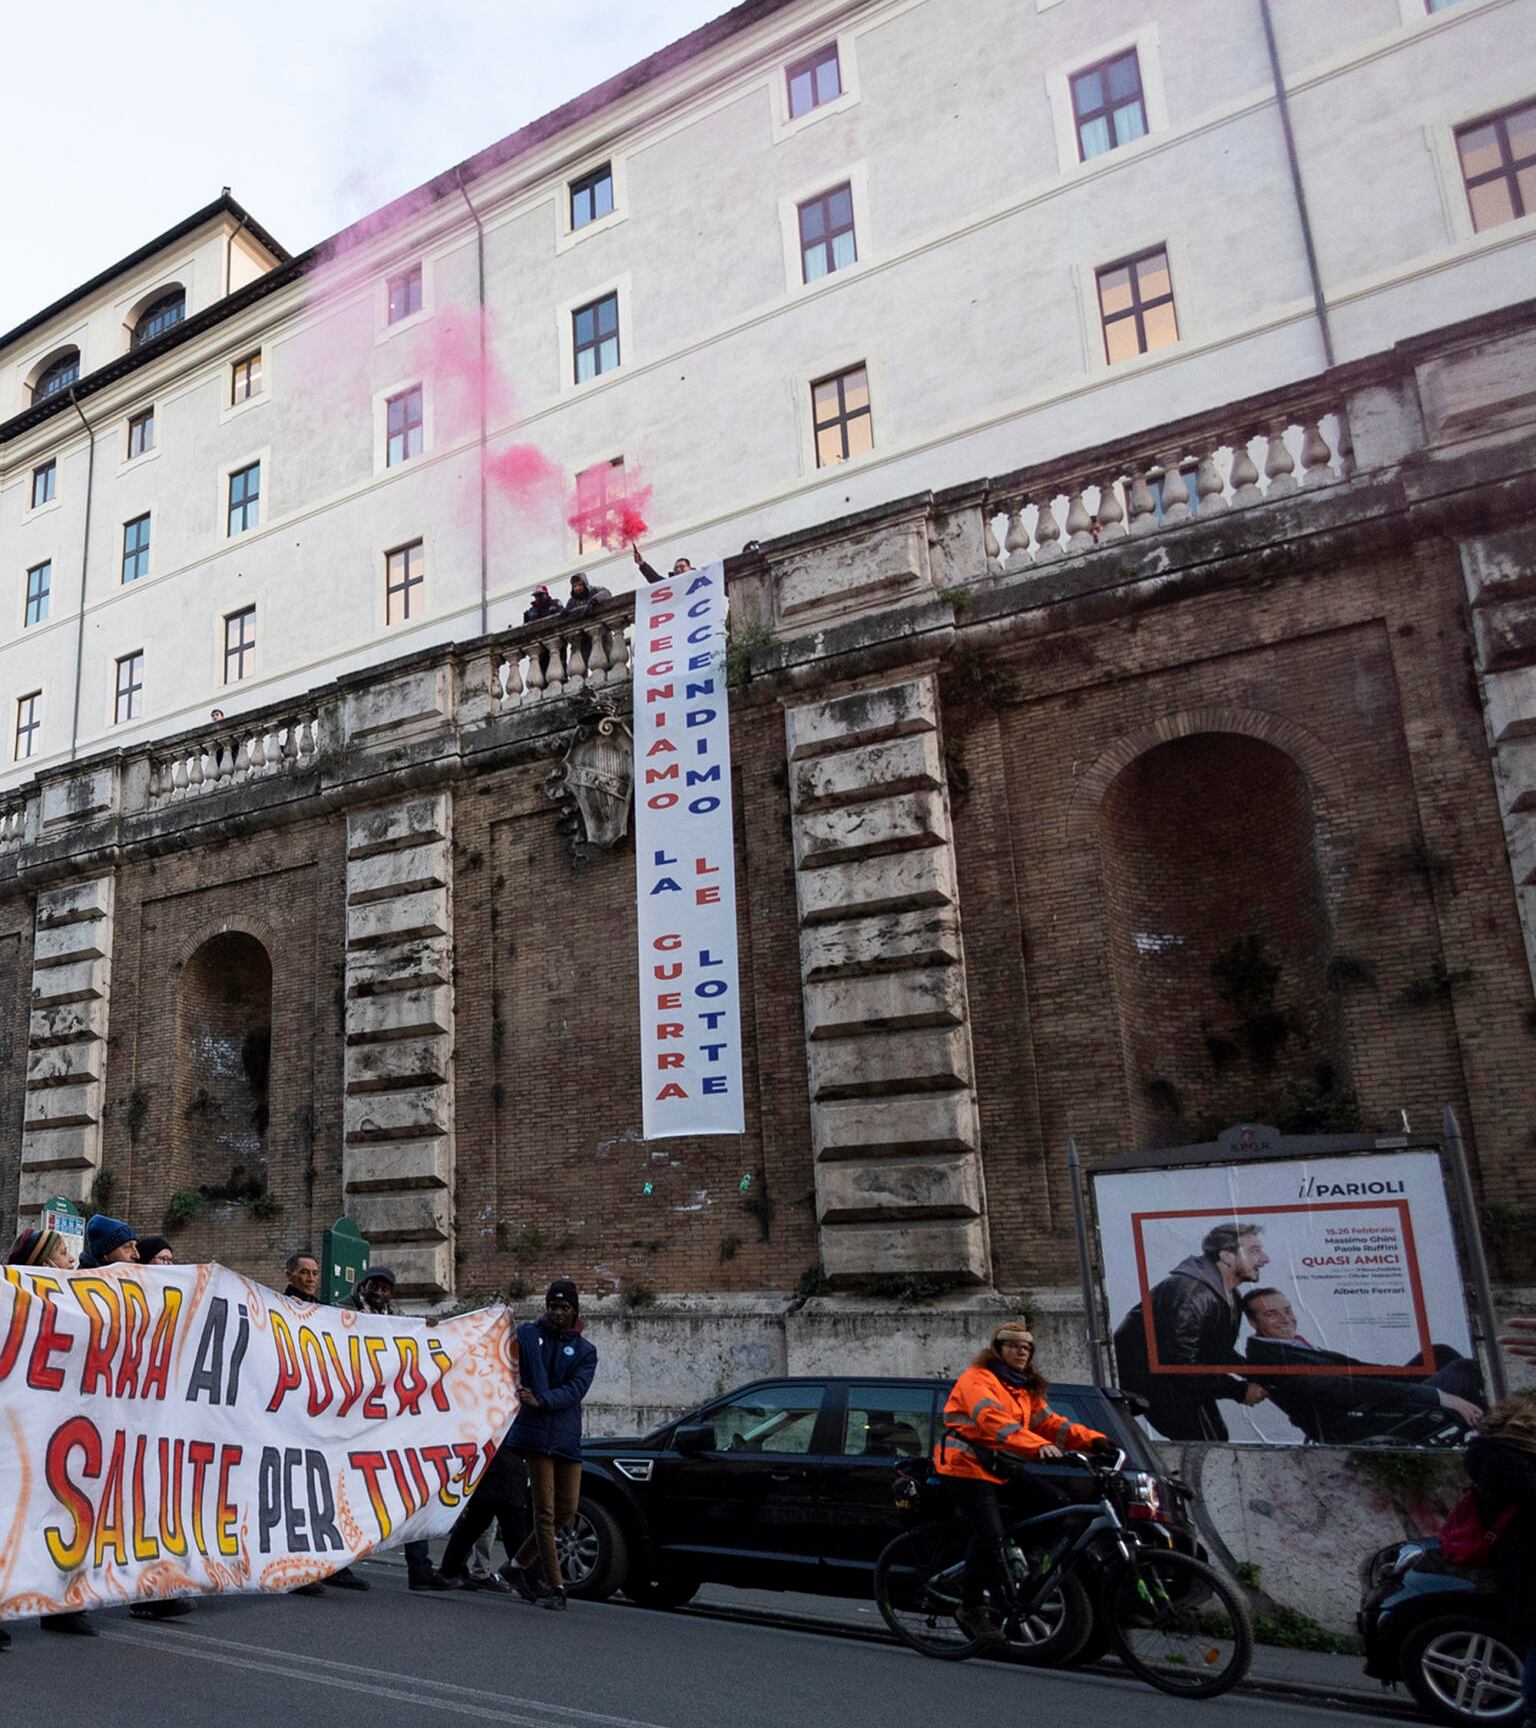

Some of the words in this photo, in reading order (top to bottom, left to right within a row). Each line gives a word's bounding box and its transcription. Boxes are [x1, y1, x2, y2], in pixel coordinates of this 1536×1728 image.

[645, 585, 680, 810] SPEGNIAMO
[684, 575, 721, 815] ACCENDIMO
[649, 849, 683, 896] LA
[695, 856, 721, 905] LE
[652, 933, 689, 1101] GUERRA
[694, 949, 728, 1095] LOTTE
[1301, 1255, 1350, 1268] QUASI
[1354, 1254, 1400, 1265] AMICI
[1324, 1236, 1368, 1245] Massimo
[1369, 1234, 1397, 1243] Ghini
[1363, 1243, 1398, 1252] Ruffini
[1333, 1287, 1369, 1295] Alberto
[1371, 1286, 1405, 1294] Ferrari
[44, 1414, 244, 1574] SALUTE
[260, 1445, 344, 1554] PER
